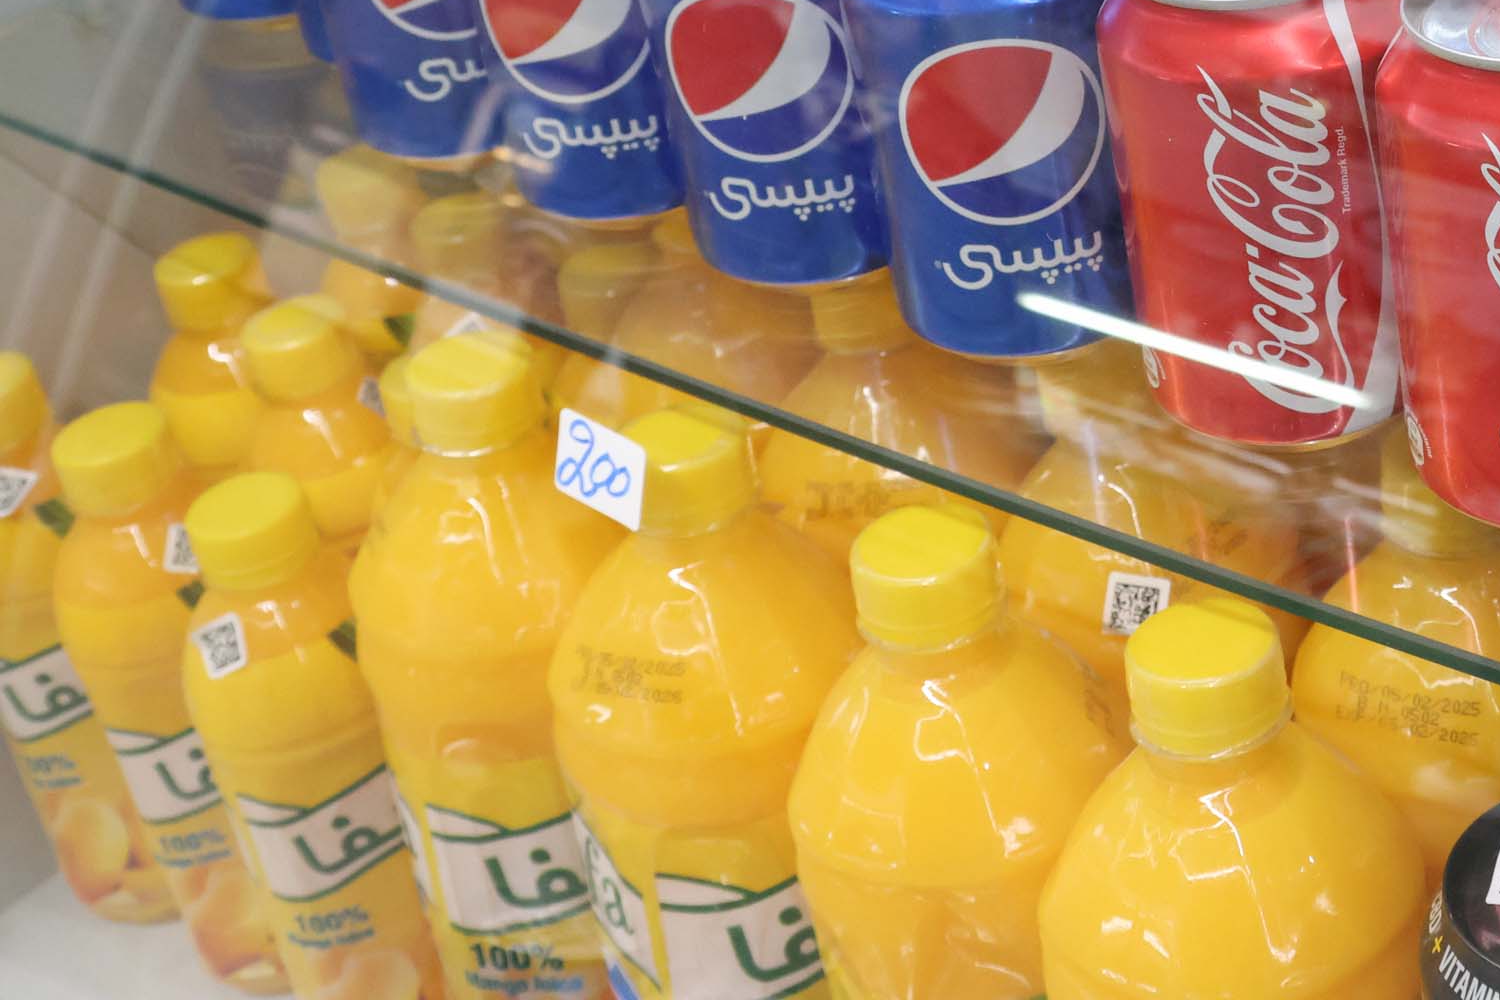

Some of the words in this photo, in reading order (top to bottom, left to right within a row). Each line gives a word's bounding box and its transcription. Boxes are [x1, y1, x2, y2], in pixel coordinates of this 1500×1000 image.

[522, 113, 659, 160] پیپسی
[1337, 126, 1347, 157] Regd.
[708, 173, 856, 222] پیپسی
[1338, 157, 1351, 215] Trademark
[941, 229, 1104, 291] پیپسی
[1196, 64, 1355, 414] Coca-Cola
[555, 419, 631, 497] 200
[469, 943, 566, 971] 100%
